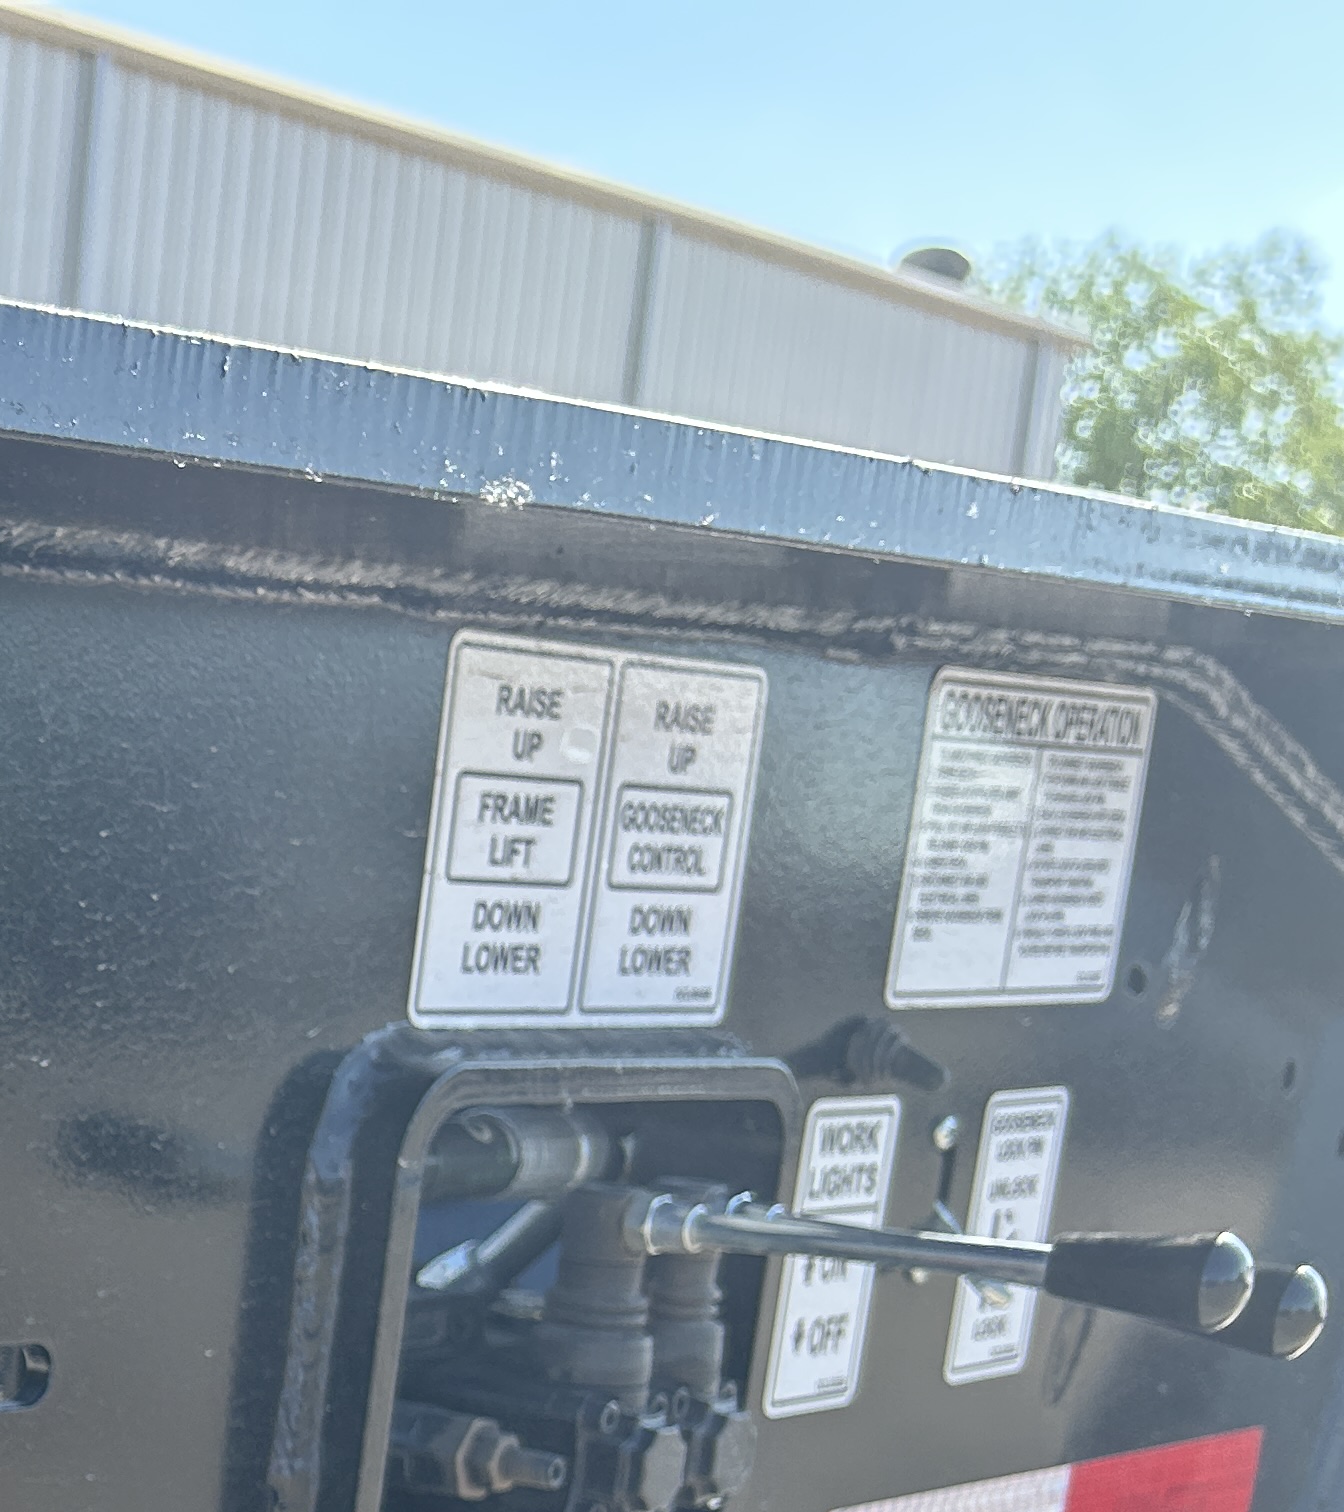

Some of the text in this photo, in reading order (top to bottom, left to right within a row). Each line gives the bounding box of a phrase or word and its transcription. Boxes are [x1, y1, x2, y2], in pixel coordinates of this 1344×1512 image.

[496, 683, 564, 721] RAISE
[654, 699, 717, 736] RAISE
[513, 728, 544, 762] UP
[668, 741, 697, 774] UP
[477, 791, 556, 827] FRAME
[621, 800, 725, 837] GOOSENECK
[488, 834, 537, 868] LIFT
[627, 841, 707, 876] CONTROL
[473, 899, 542, 933] DOWN
[629, 904, 693, 937] DOWN
[460, 940, 542, 975] LOWER
[619, 944, 693, 978] LOWER
[808, 1162, 879, 1199] LIGHTS
[808, 1314, 850, 1357] OFF
